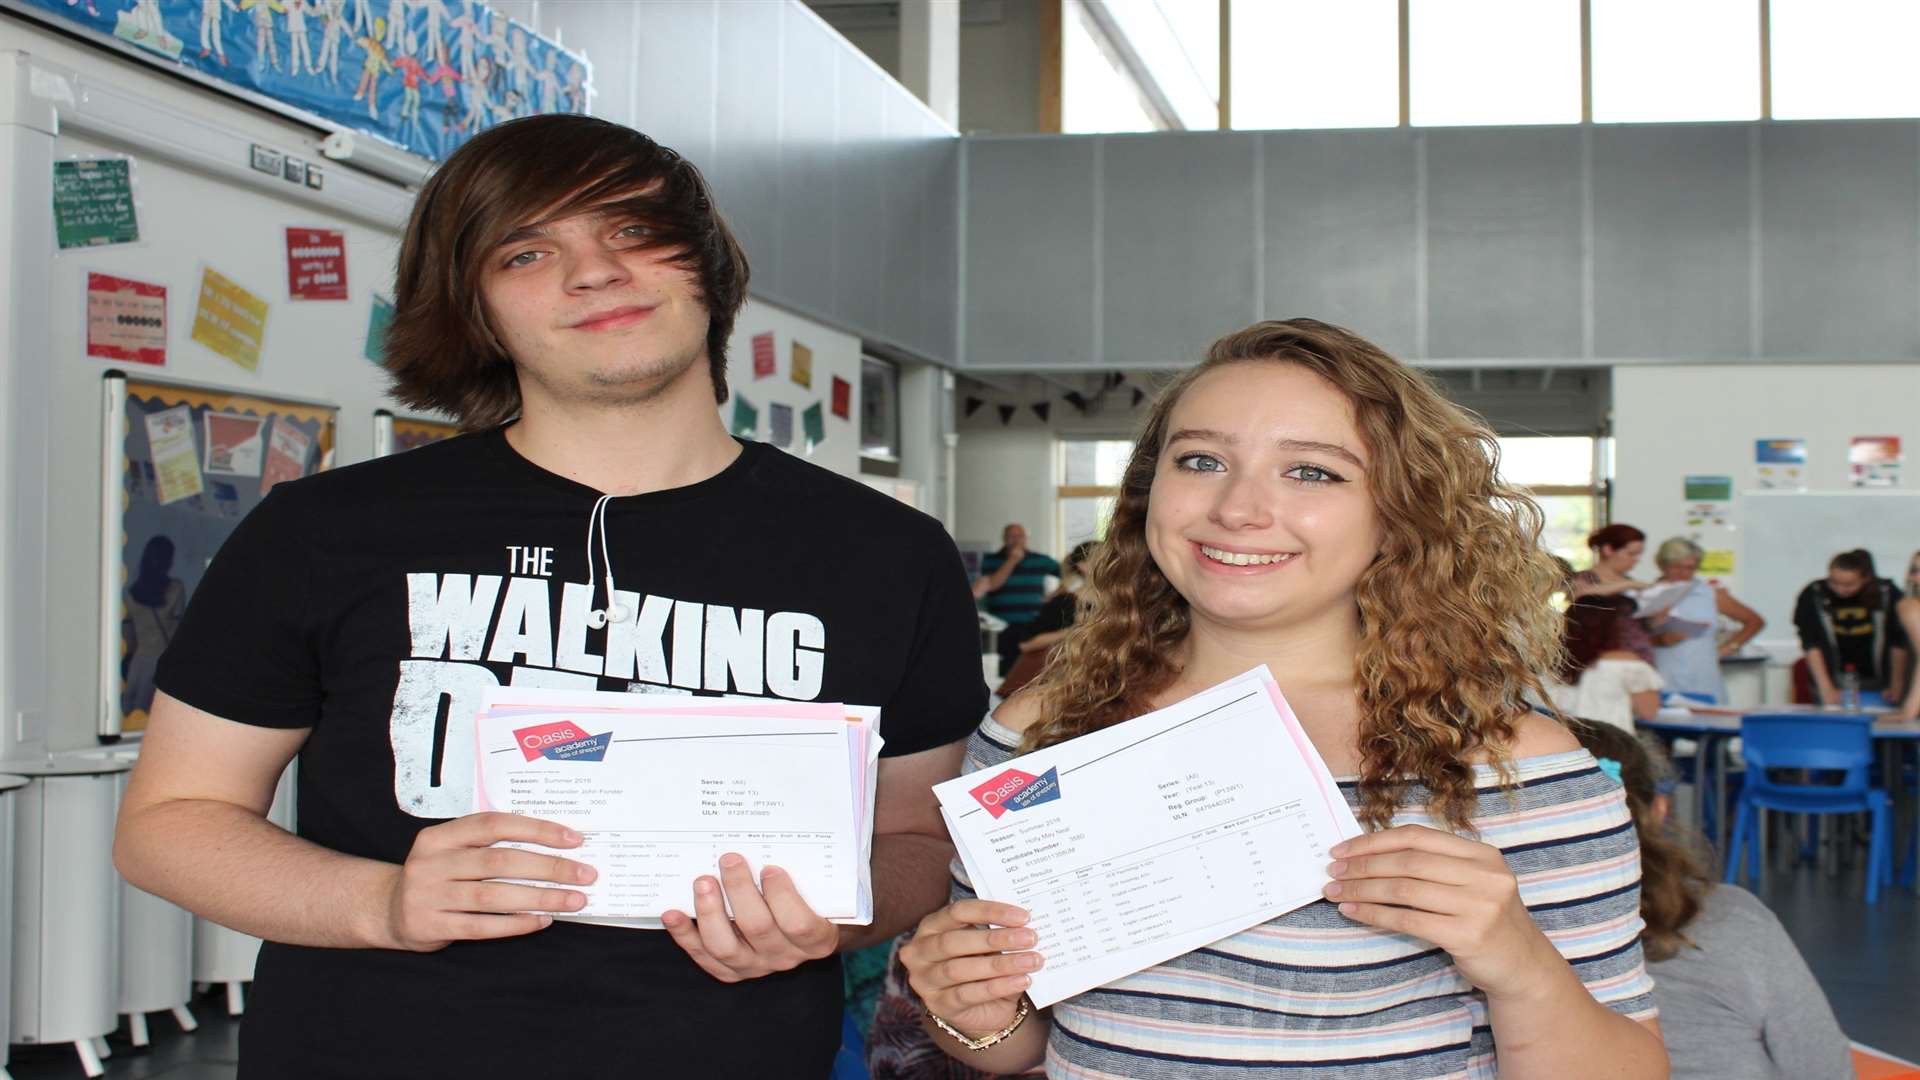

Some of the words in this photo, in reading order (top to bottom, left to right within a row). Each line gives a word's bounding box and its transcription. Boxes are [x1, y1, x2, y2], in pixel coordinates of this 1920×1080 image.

[506, 546, 554, 577] THE
[406, 572, 825, 702] WALKING
[523, 729, 575, 749] Oasis
[555, 738, 598, 753] academy
[510, 777, 539, 785] Season:
[544, 777, 573, 785] Summer
[1157, 779, 1181, 791] Series:
[982, 776, 1024, 806] Oasis
[1013, 778, 1048, 803] academy
[1162, 791, 1181, 800] Year:
[1185, 795, 1207, 806] Group:
[990, 832, 1015, 844] Season:
[1019, 823, 1045, 834] Summer
[995, 844, 1015, 854] Name:
[1001, 850, 1033, 864] Candidate
[1034, 841, 1061, 854] Number:
[1011, 874, 1029, 885] Exam
[1030, 868, 1053, 878] Results
